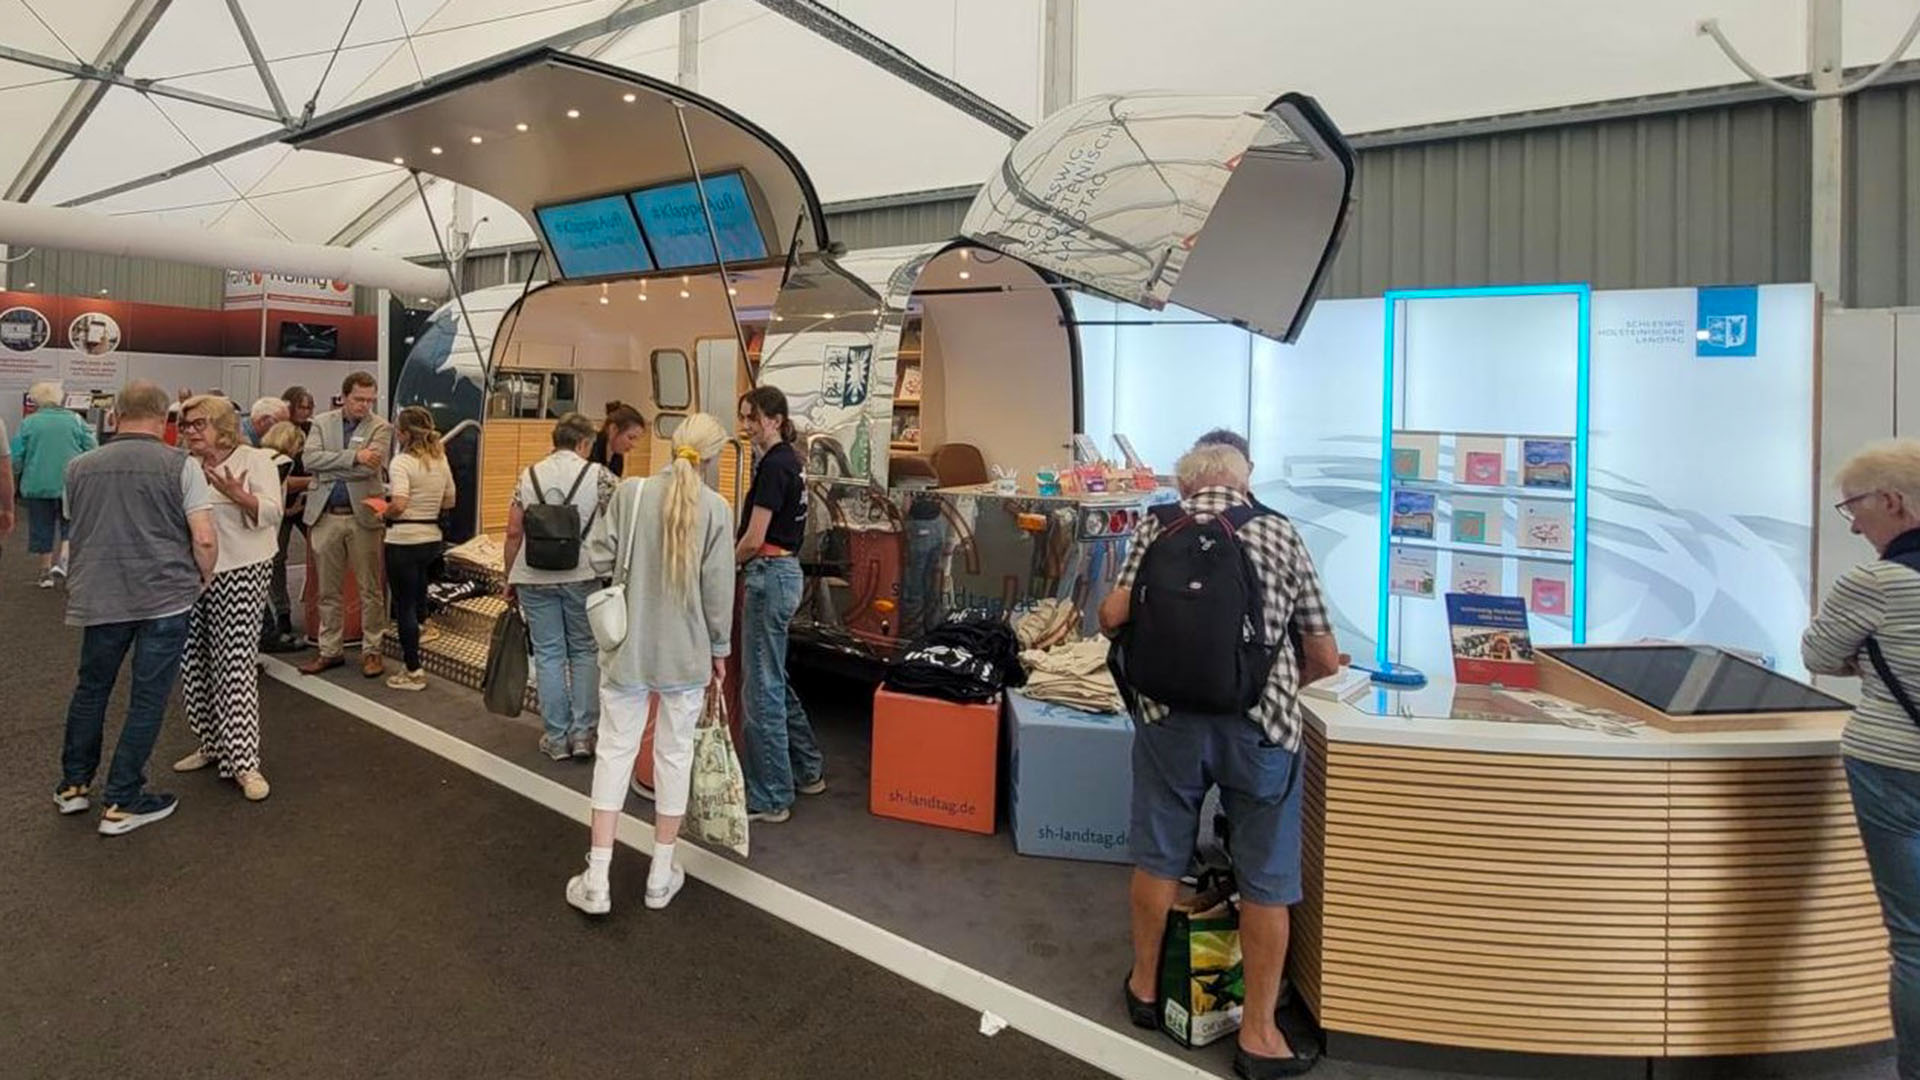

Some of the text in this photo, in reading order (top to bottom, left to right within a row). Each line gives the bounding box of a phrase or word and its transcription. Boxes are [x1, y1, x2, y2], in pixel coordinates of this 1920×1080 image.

[1025, 147, 1084, 251] SCHESWIG
[1634, 336, 1685, 344] LANDTAG
[889, 790, 976, 816] sh-landtag.de
[1038, 825, 1129, 849] sh-landtag.d
